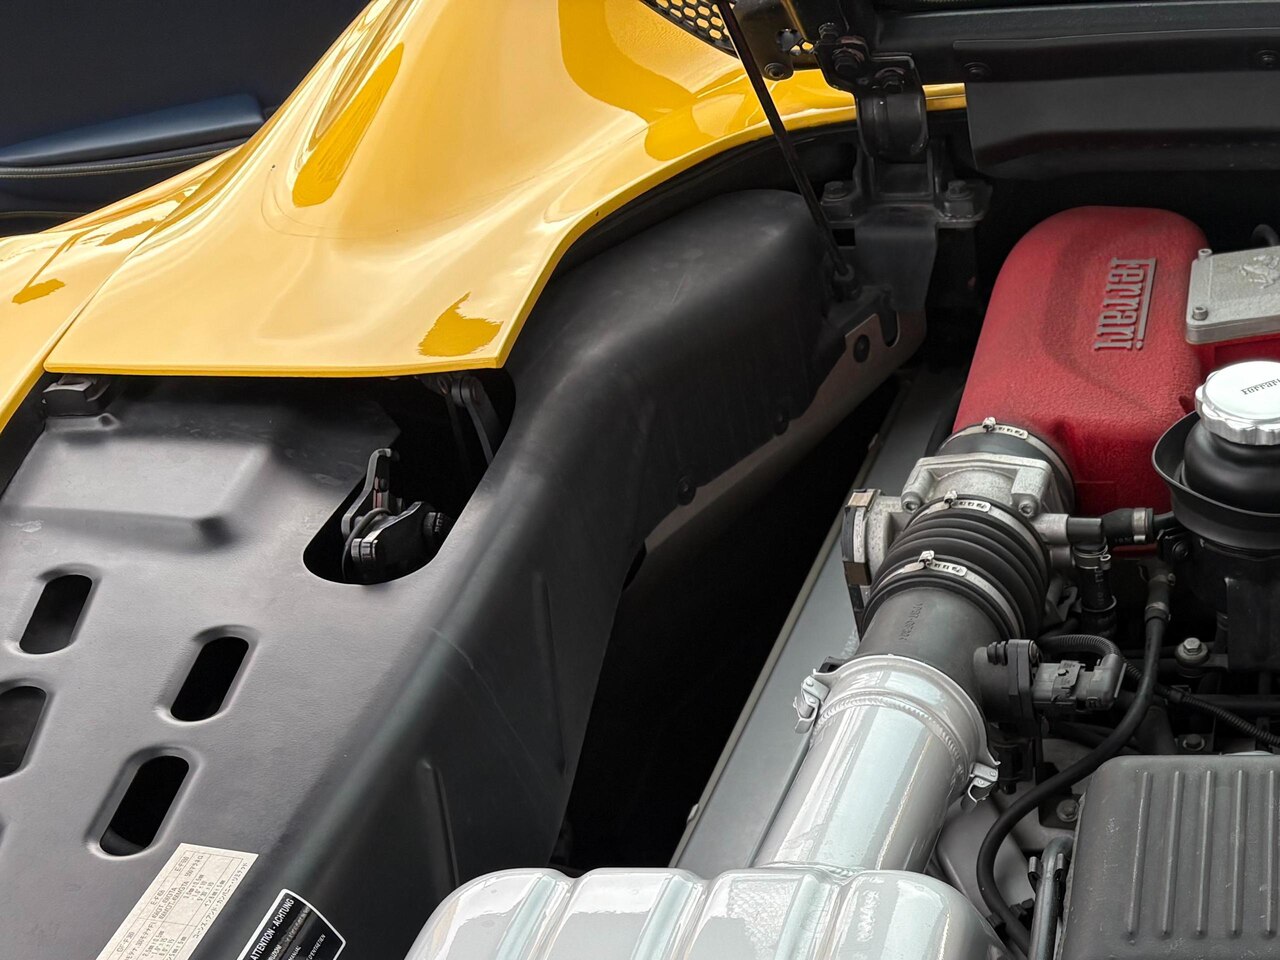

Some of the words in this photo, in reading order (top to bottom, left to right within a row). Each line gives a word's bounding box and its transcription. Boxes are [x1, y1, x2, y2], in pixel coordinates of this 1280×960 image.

[1094, 257, 1156, 351] Ferrari
[250, 928, 274, 960] ATTENTION
[273, 897, 294, 926] ACHTUNG
